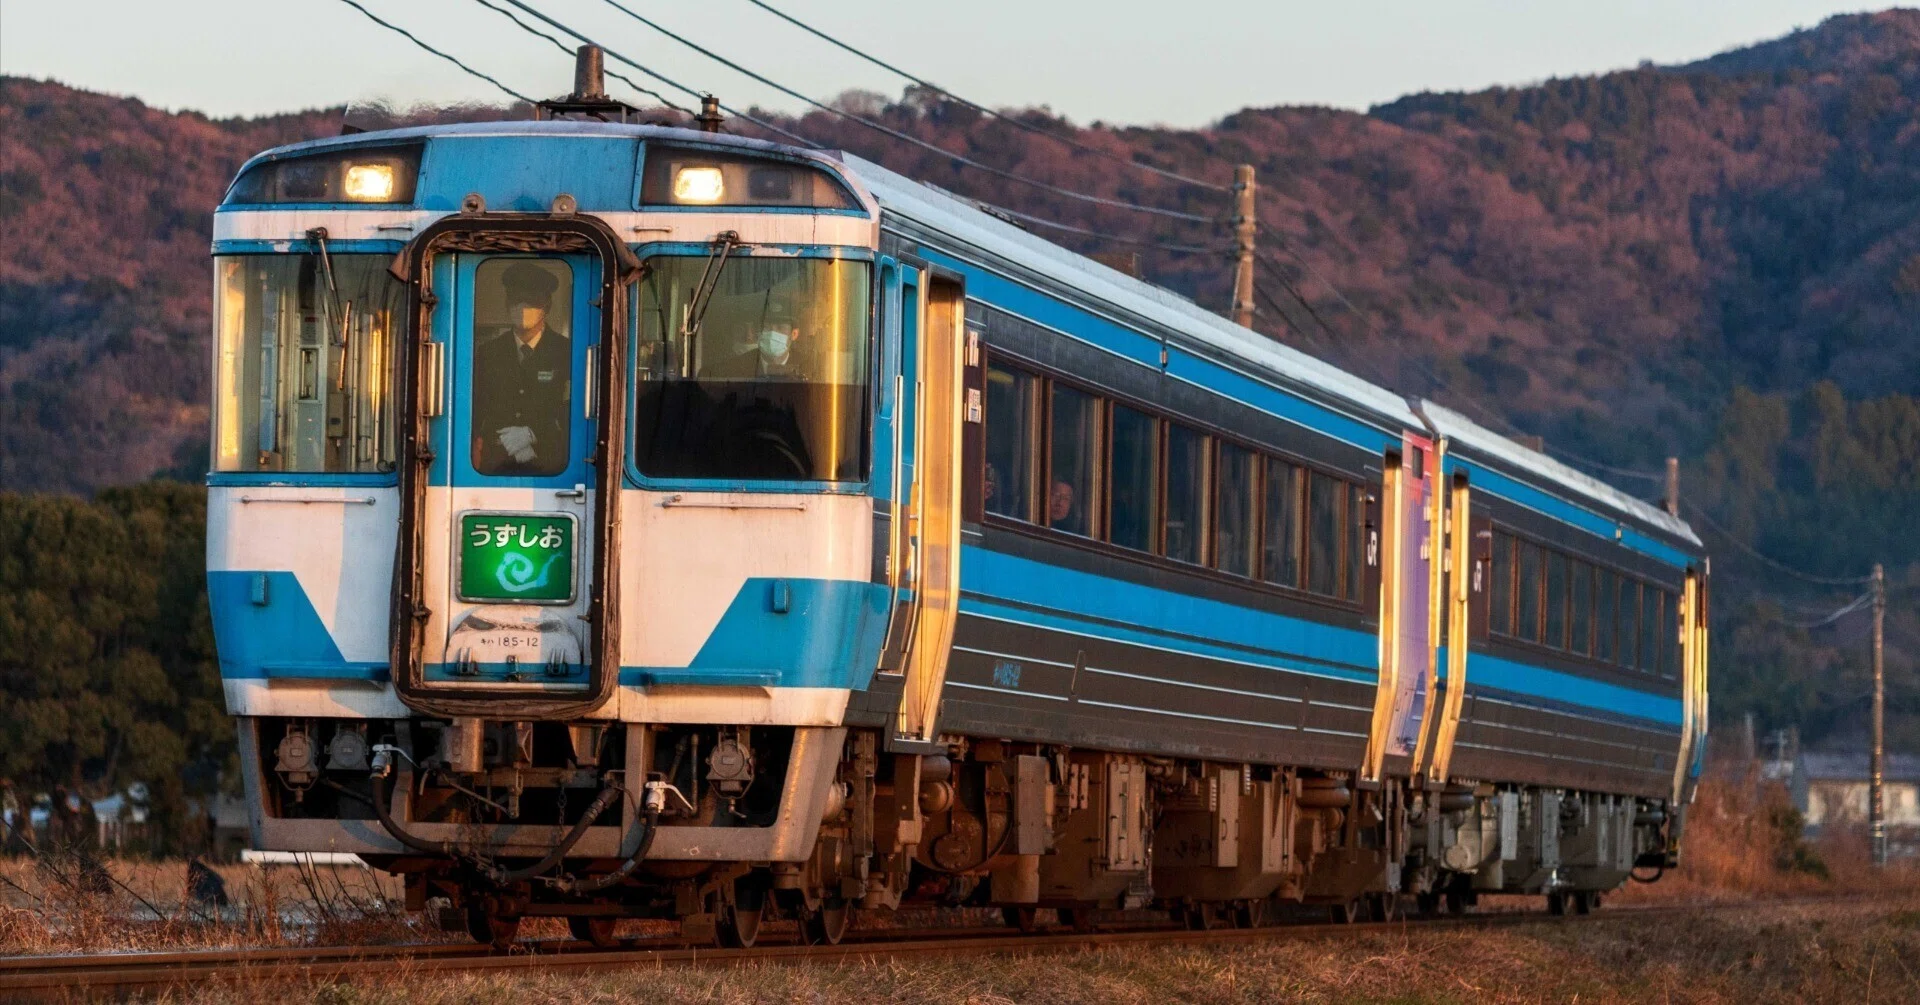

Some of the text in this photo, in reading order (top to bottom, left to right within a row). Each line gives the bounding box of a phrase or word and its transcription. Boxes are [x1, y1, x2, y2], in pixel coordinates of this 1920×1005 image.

[470, 523, 564, 548] うずしお
[1367, 531, 1377, 566] JR
